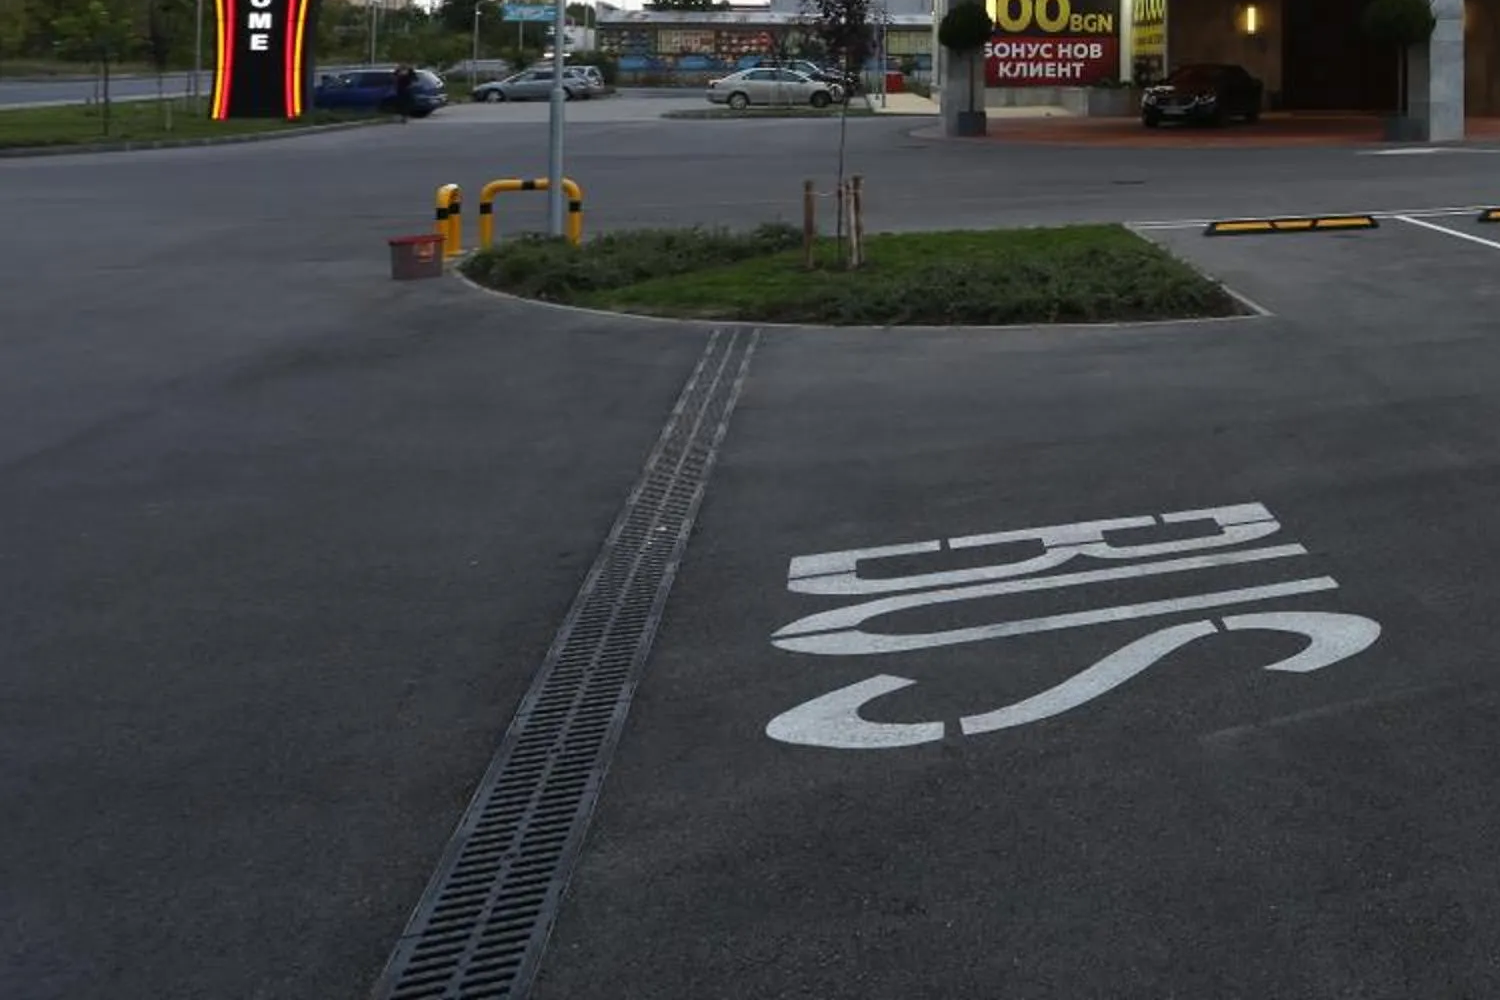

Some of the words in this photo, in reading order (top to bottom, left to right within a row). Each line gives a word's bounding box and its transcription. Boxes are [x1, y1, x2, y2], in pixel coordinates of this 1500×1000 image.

[1057, 43, 1103, 60] НОВ
[999, 61, 1085, 78] КЛИЕНТ
[766, 502, 1381, 748] BUS
